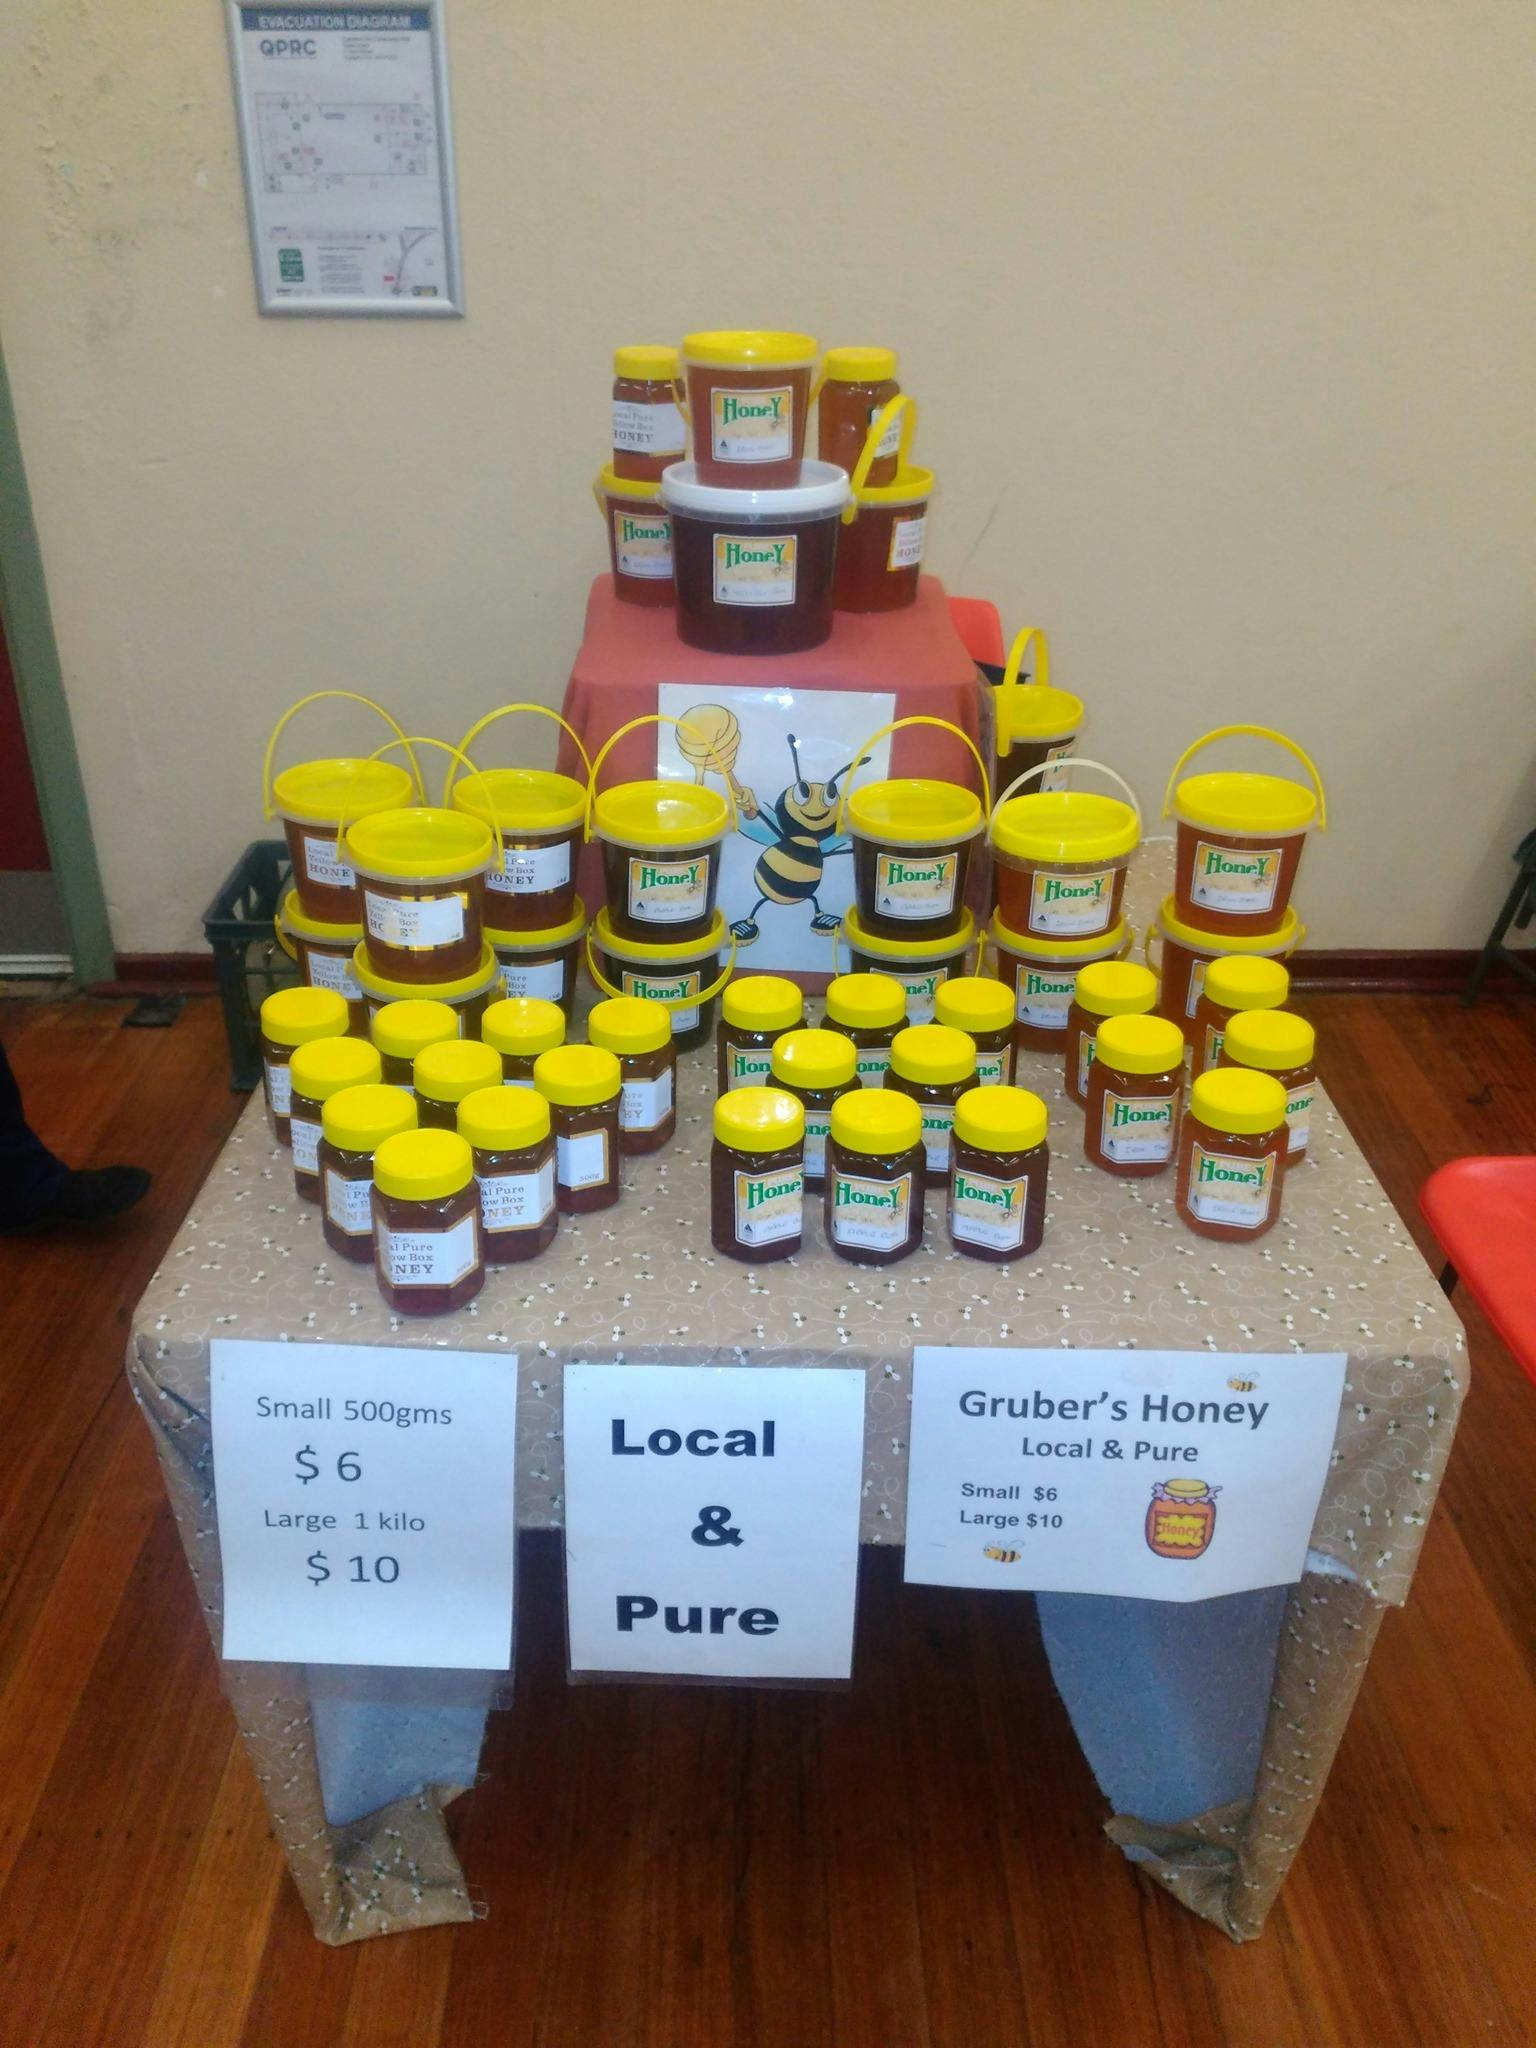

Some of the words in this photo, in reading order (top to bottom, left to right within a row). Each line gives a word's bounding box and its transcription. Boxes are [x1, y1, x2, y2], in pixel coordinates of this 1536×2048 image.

[258, 15, 345, 29] EVACUATION
[347, 15, 412, 29] DIAGRAM
[260, 39, 317, 56] QPRC
[310, 864, 351, 877] HONE
[314, 976, 353, 991] HONE
[906, 976, 937, 995] neY
[1026, 974, 1076, 995] Hone
[735, 1055, 771, 1077] Hon
[1285, 1098, 1312, 1114] one
[921, 1118, 954, 1130] one
[496, 1186, 524, 1195] Pure
[502, 1196, 524, 1204] Box
[488, 1205, 525, 1217] NEY
[402, 1242, 433, 1252] Pure
[409, 1253, 433, 1261] Box
[394, 1264, 434, 1275] NEY
[256, 1396, 331, 1420] Small
[344, 1400, 452, 1428] 500gms
[958, 1390, 1129, 1421] Gruber's
[1141, 1394, 1270, 1430] Honey
[611, 1419, 775, 1457] Local
[1022, 1437, 1092, 1459] Local
[1102, 1439, 1124, 1460] &
[1135, 1441, 1199, 1462] Pure
[295, 1444, 320, 1485] $
[337, 1451, 362, 1482] 6
[961, 1483, 1020, 1500] Small
[1033, 1485, 1058, 1502] $6
[264, 1509, 337, 1533] Large
[355, 1512, 369, 1530] 1
[379, 1512, 425, 1531] kilo
[691, 1505, 744, 1547] &
[960, 1510, 1020, 1529] Large
[1026, 1512, 1063, 1529] $10
[1162, 1522, 1201, 1539] Honey
[307, 1550, 331, 1586] $
[349, 1556, 400, 1584] 10
[616, 1595, 779, 1636] Pure
